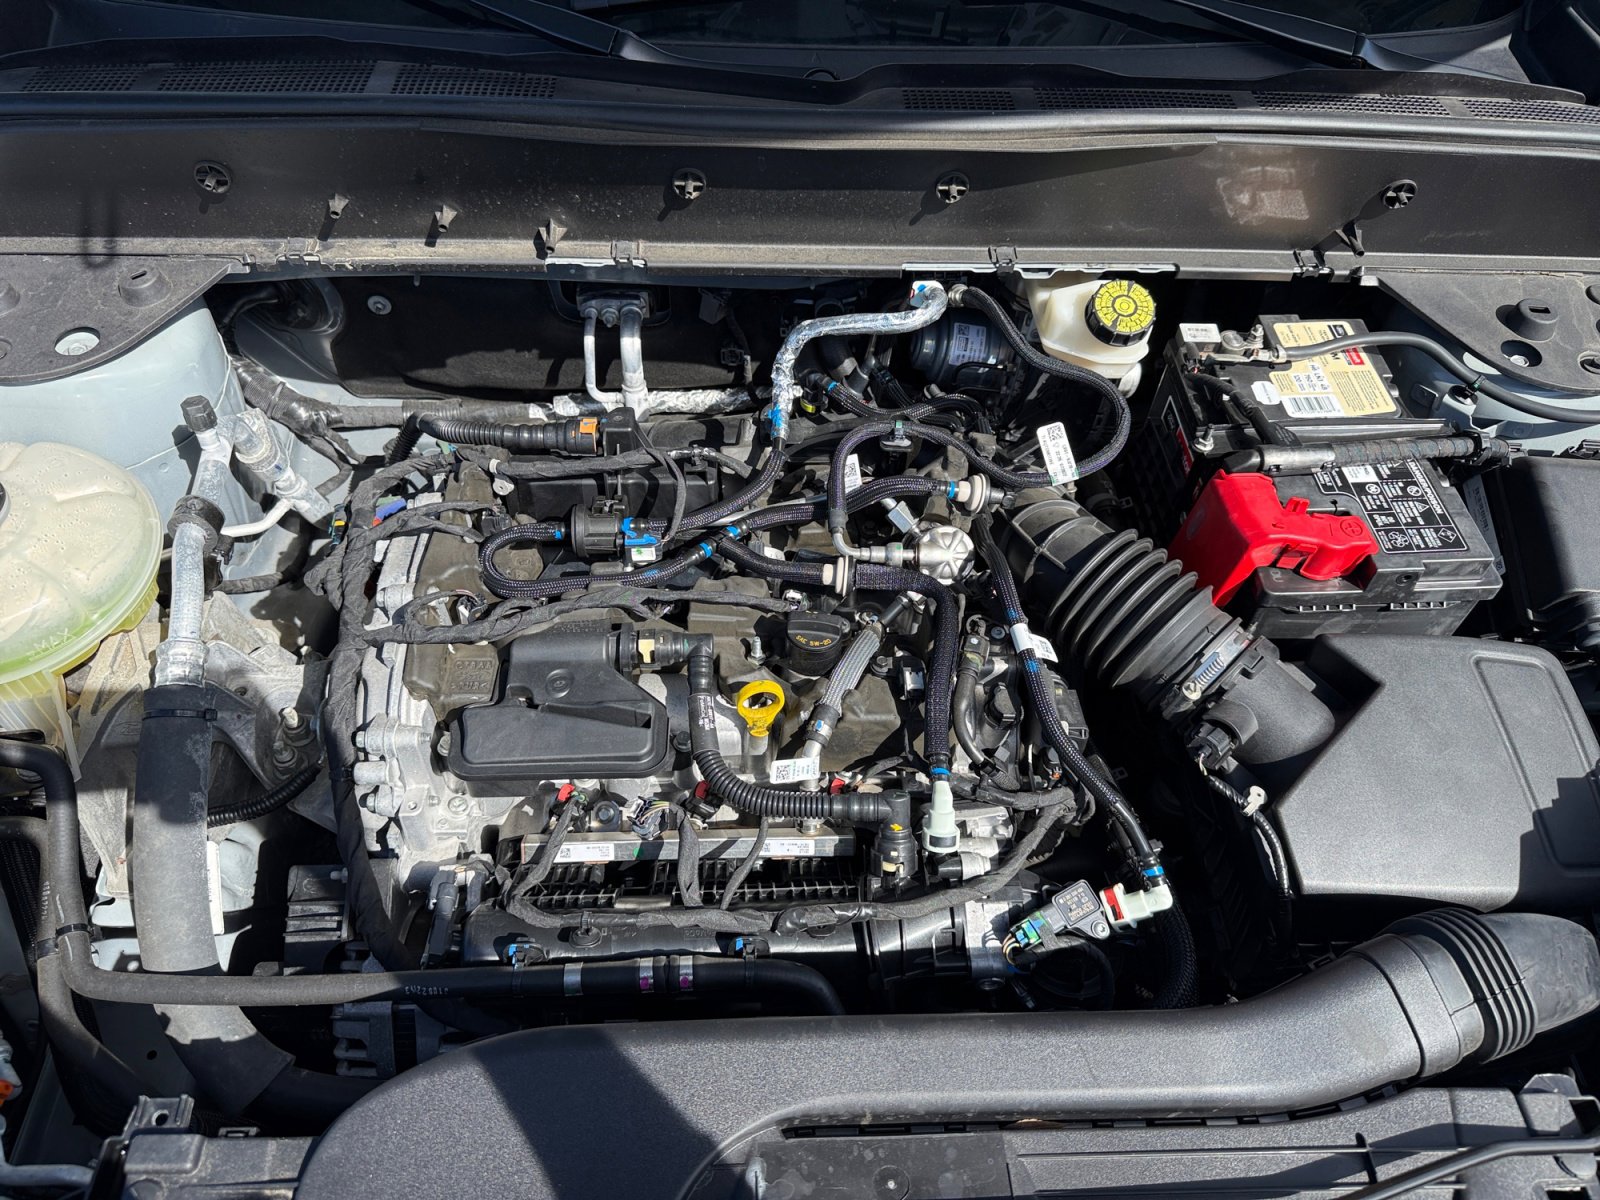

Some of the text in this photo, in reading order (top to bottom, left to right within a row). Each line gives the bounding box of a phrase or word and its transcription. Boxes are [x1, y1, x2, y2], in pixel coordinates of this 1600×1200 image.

[1408, 462, 1443, 513] DANGER/POISON
[34, 628, 75, 654] MAX
[796, 634, 832, 646] SAE 5W-20
